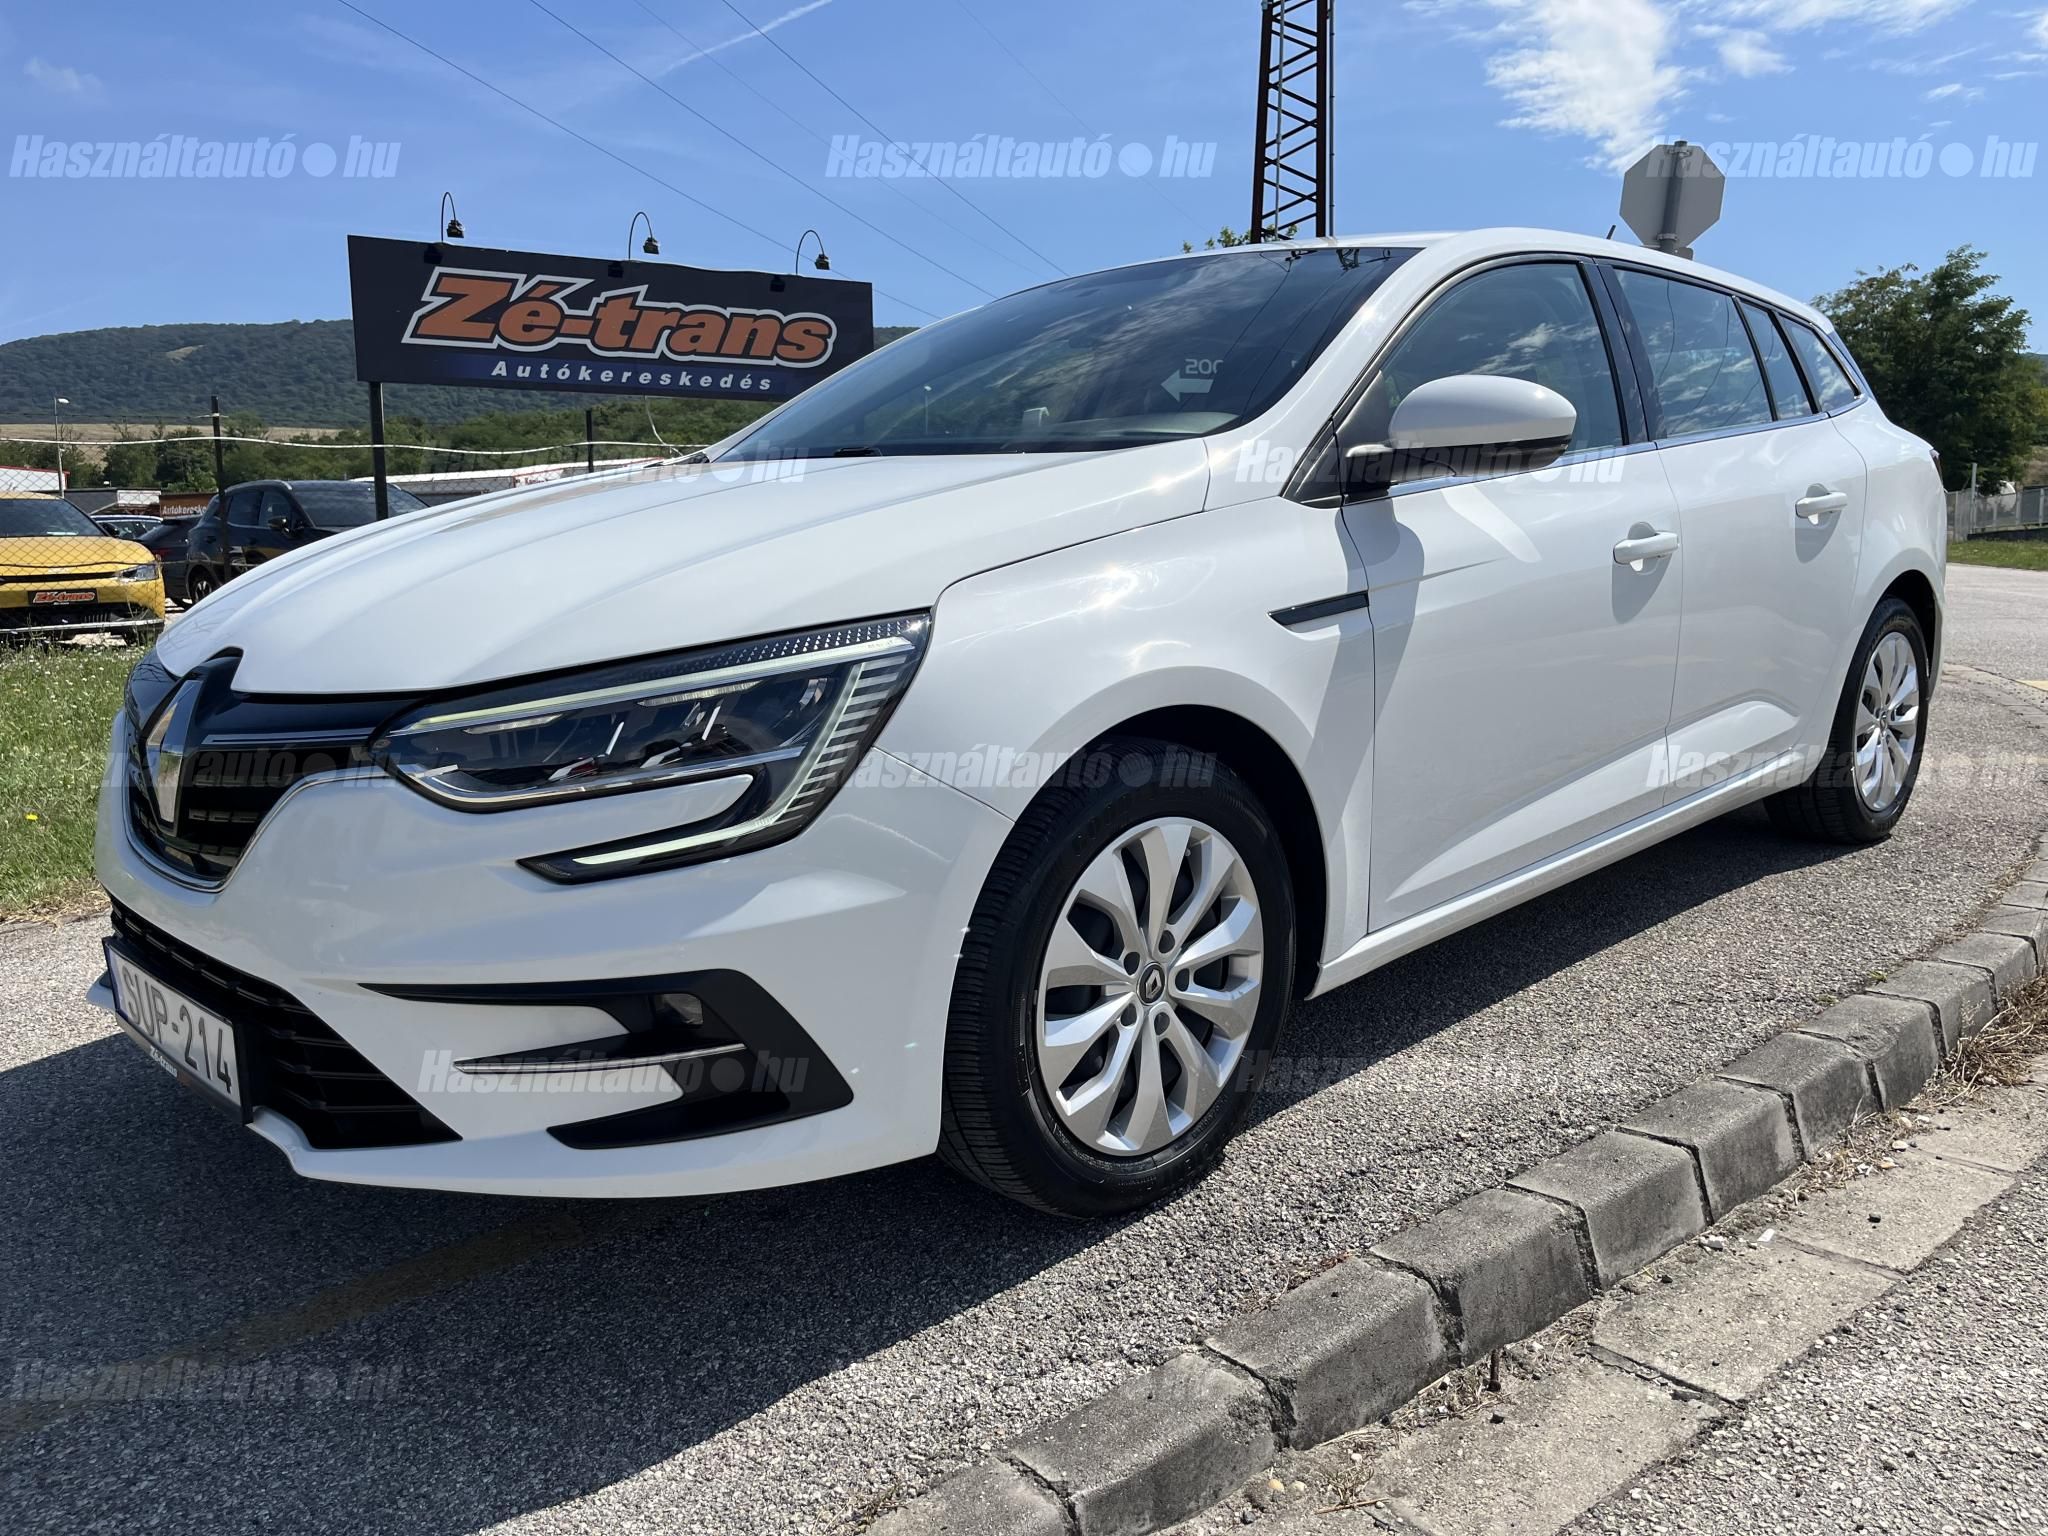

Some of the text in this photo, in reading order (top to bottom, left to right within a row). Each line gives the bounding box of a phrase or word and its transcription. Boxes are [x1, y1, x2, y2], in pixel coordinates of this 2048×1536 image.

[403, 267, 836, 366] Zé-trans
[491, 360, 773, 391] Autókereskedés
[121, 965, 232, 1094] SUP-214
